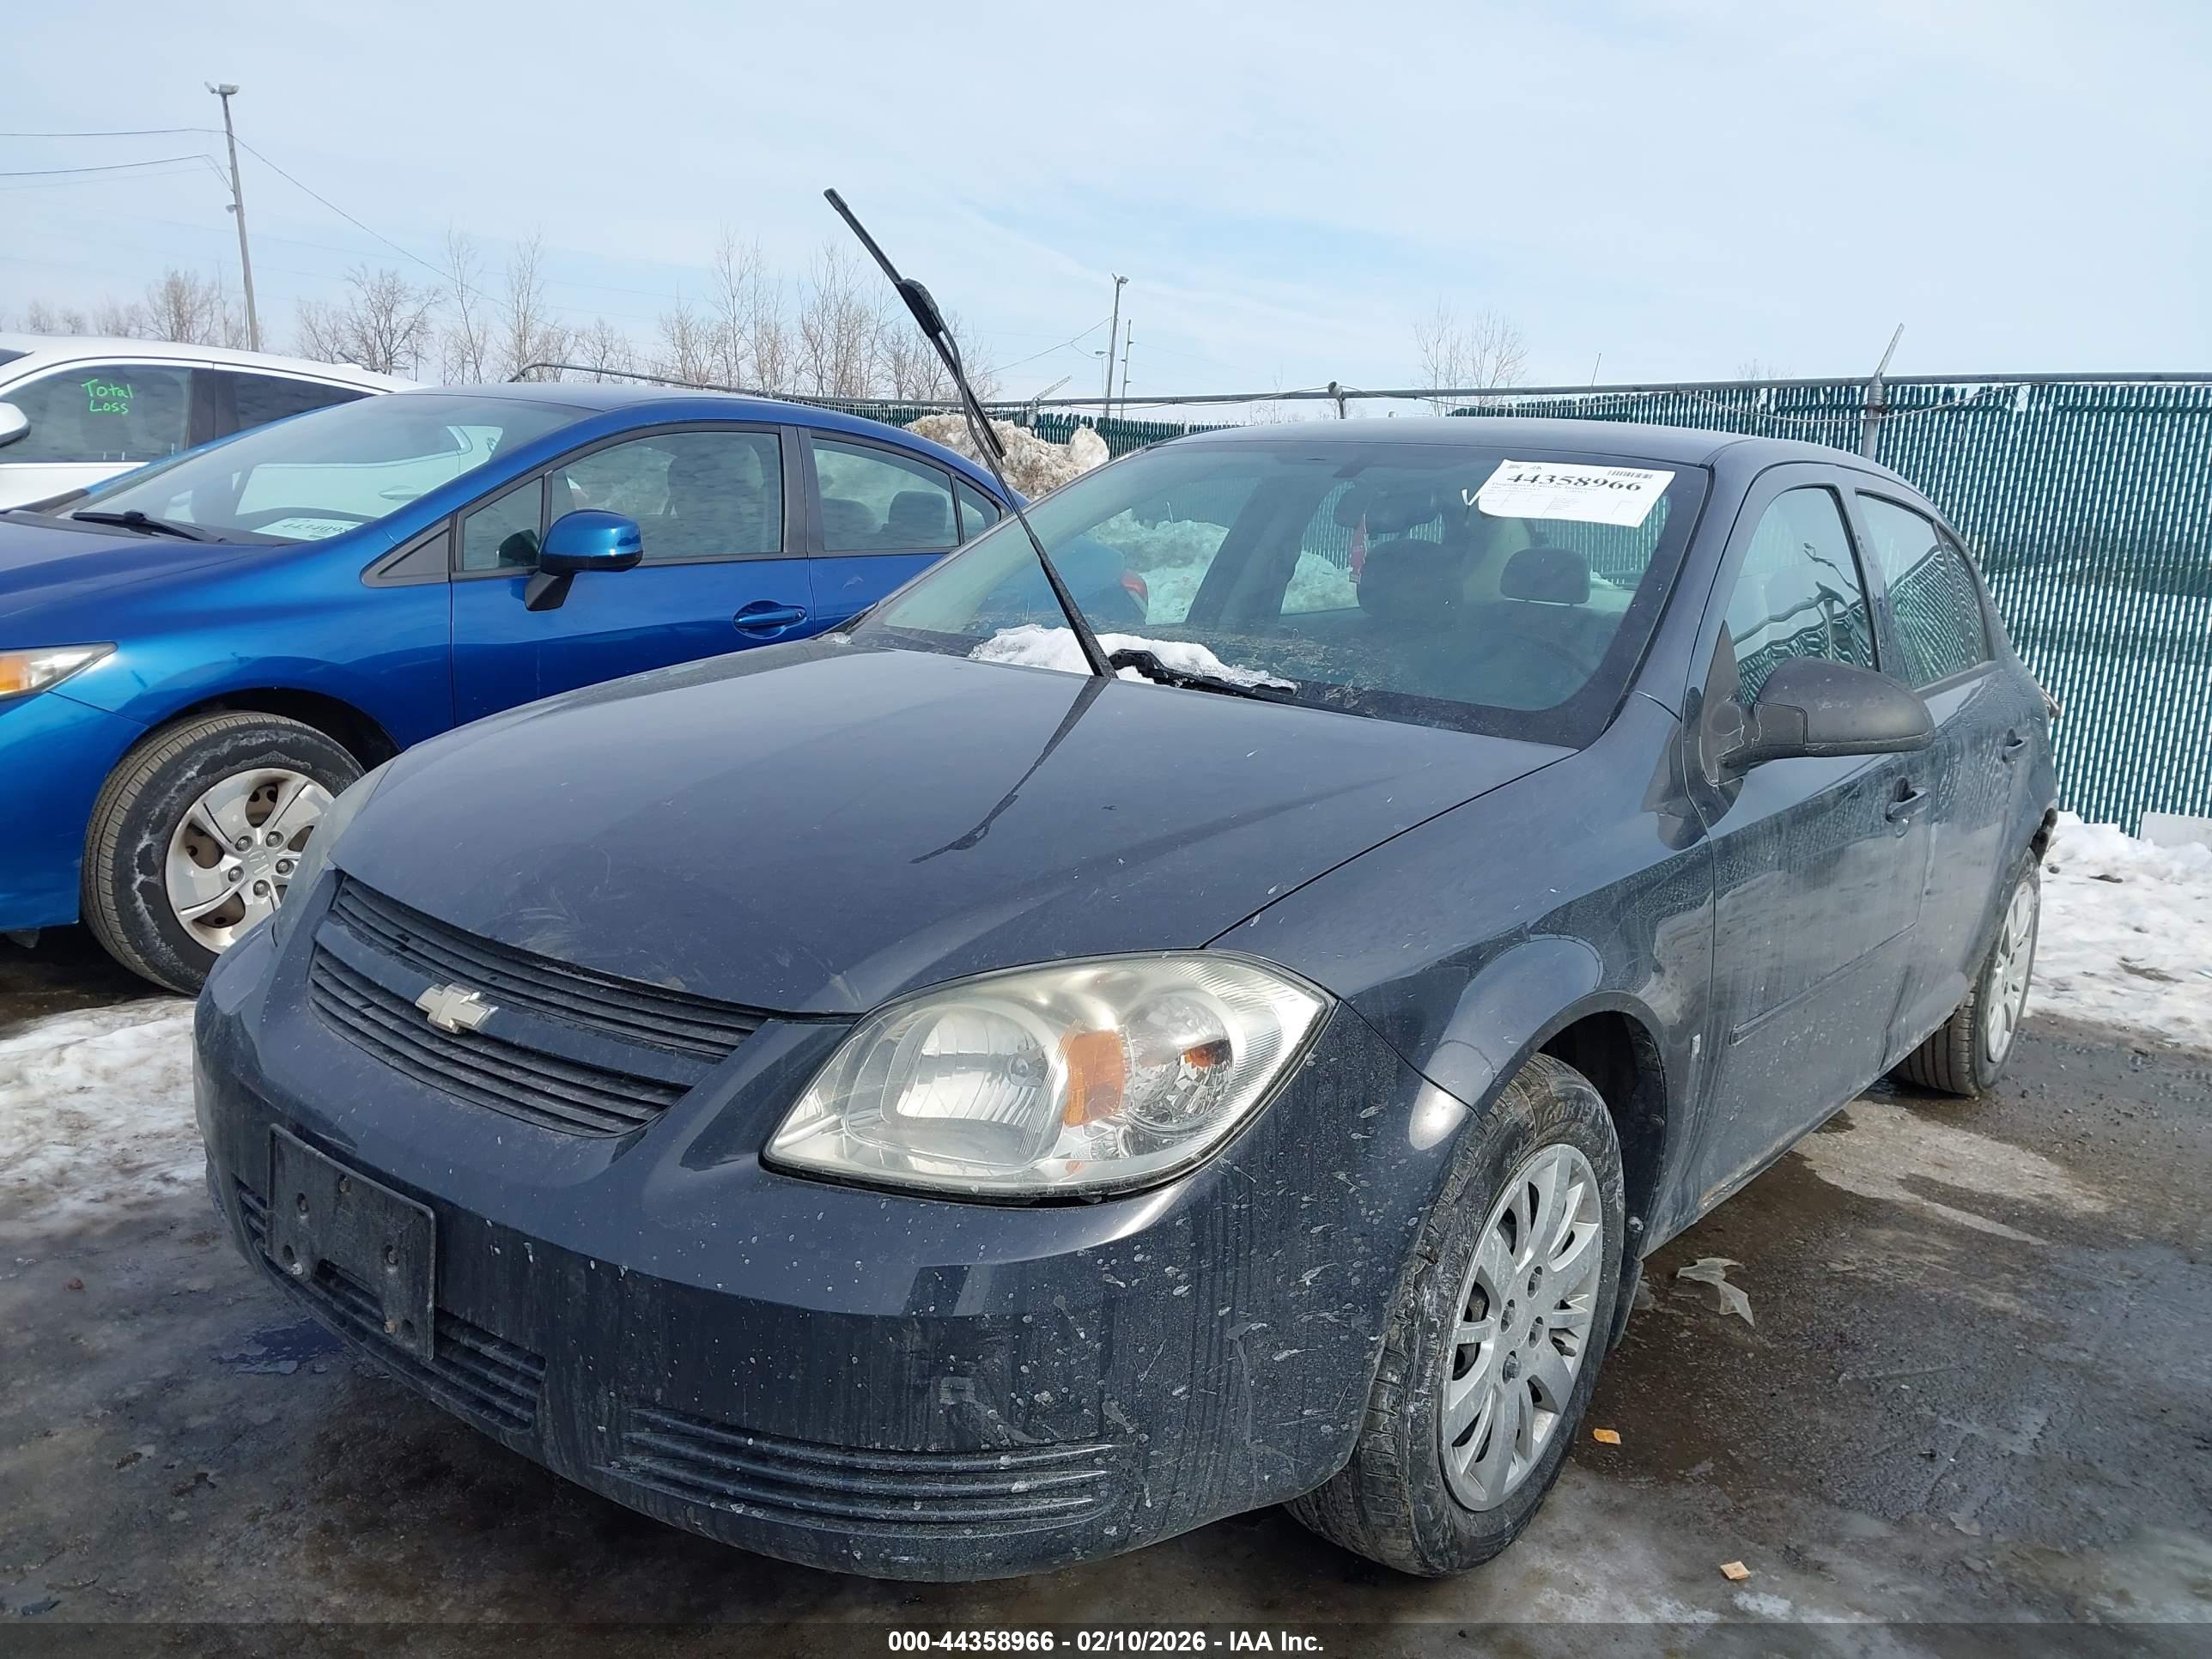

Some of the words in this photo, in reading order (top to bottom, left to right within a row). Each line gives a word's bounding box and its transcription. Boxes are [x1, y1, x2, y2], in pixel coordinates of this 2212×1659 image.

[81, 379, 134, 398] Total
[89, 399, 130, 414] Loss
[1507, 473, 1642, 491] 44358966
